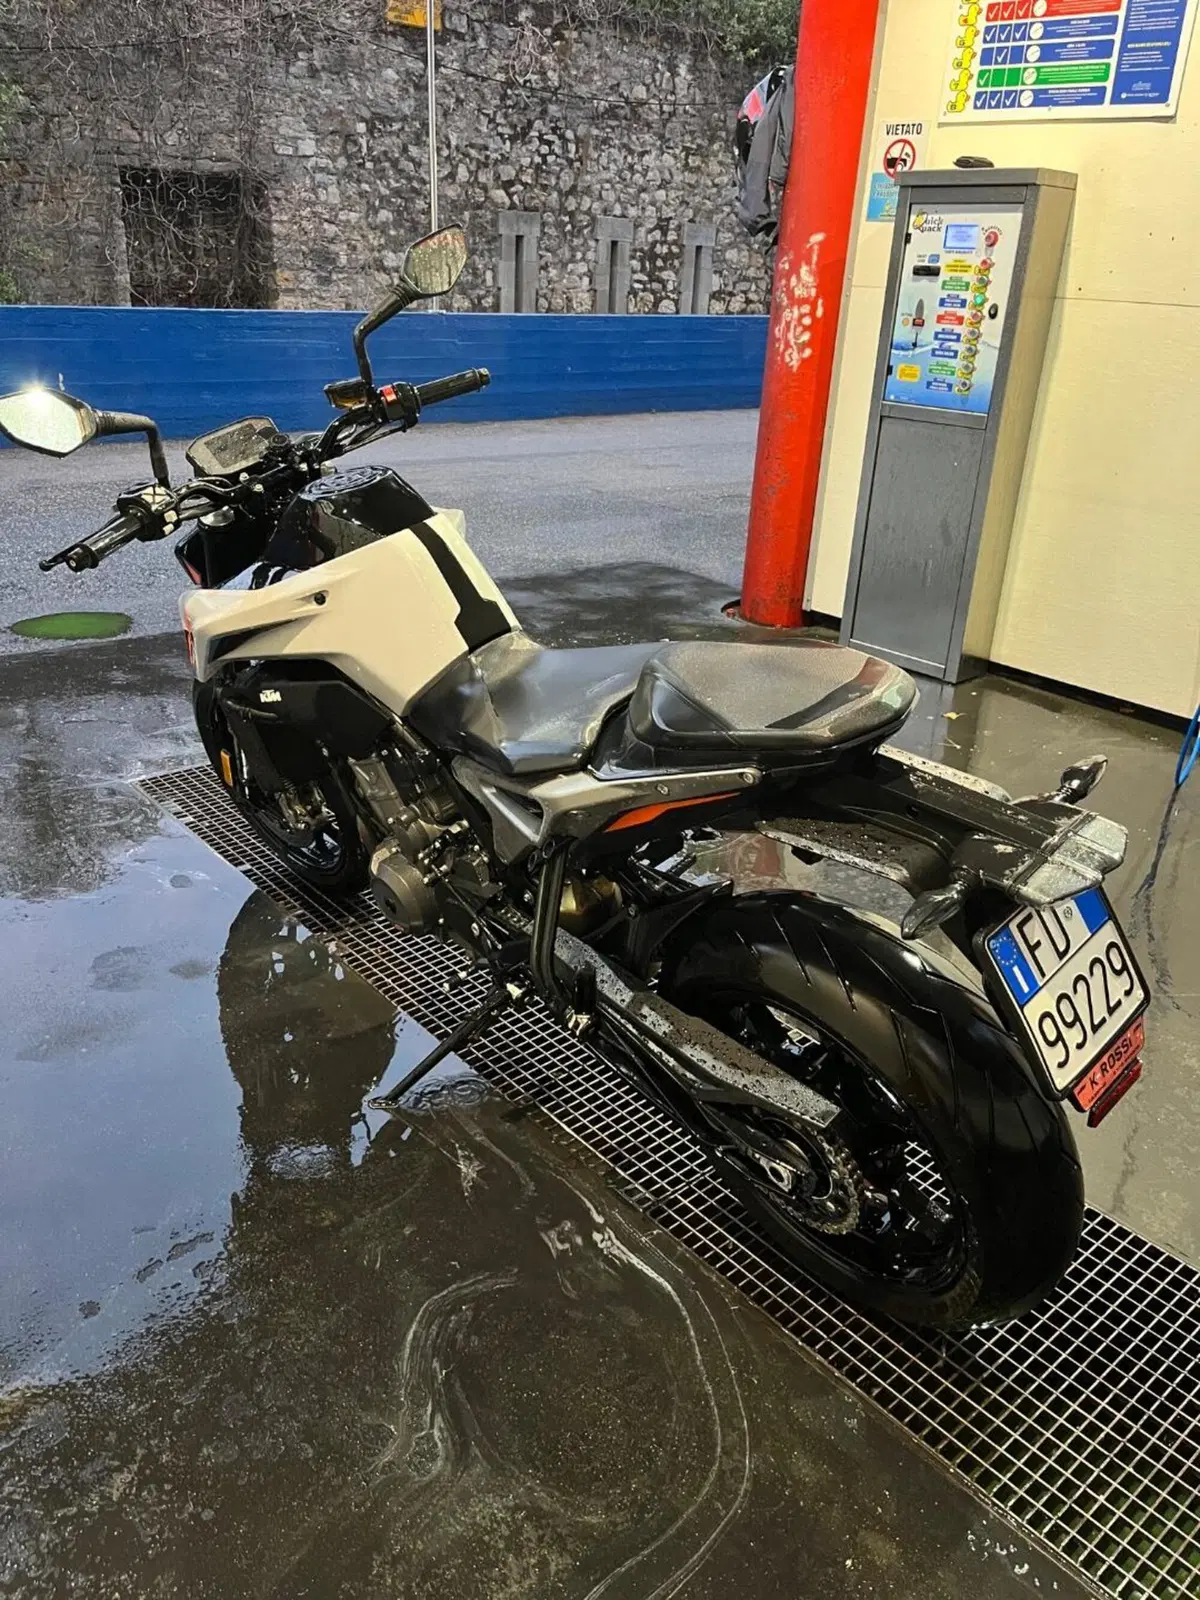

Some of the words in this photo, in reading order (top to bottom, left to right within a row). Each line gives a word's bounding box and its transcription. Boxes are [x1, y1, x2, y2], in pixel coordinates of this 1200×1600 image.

[885, 123, 923, 136] VIETATO
[260, 689, 281, 703] KTM
[1037, 940, 1134, 1069] 99229
[1100, 1037, 1133, 1078] ROSSI
